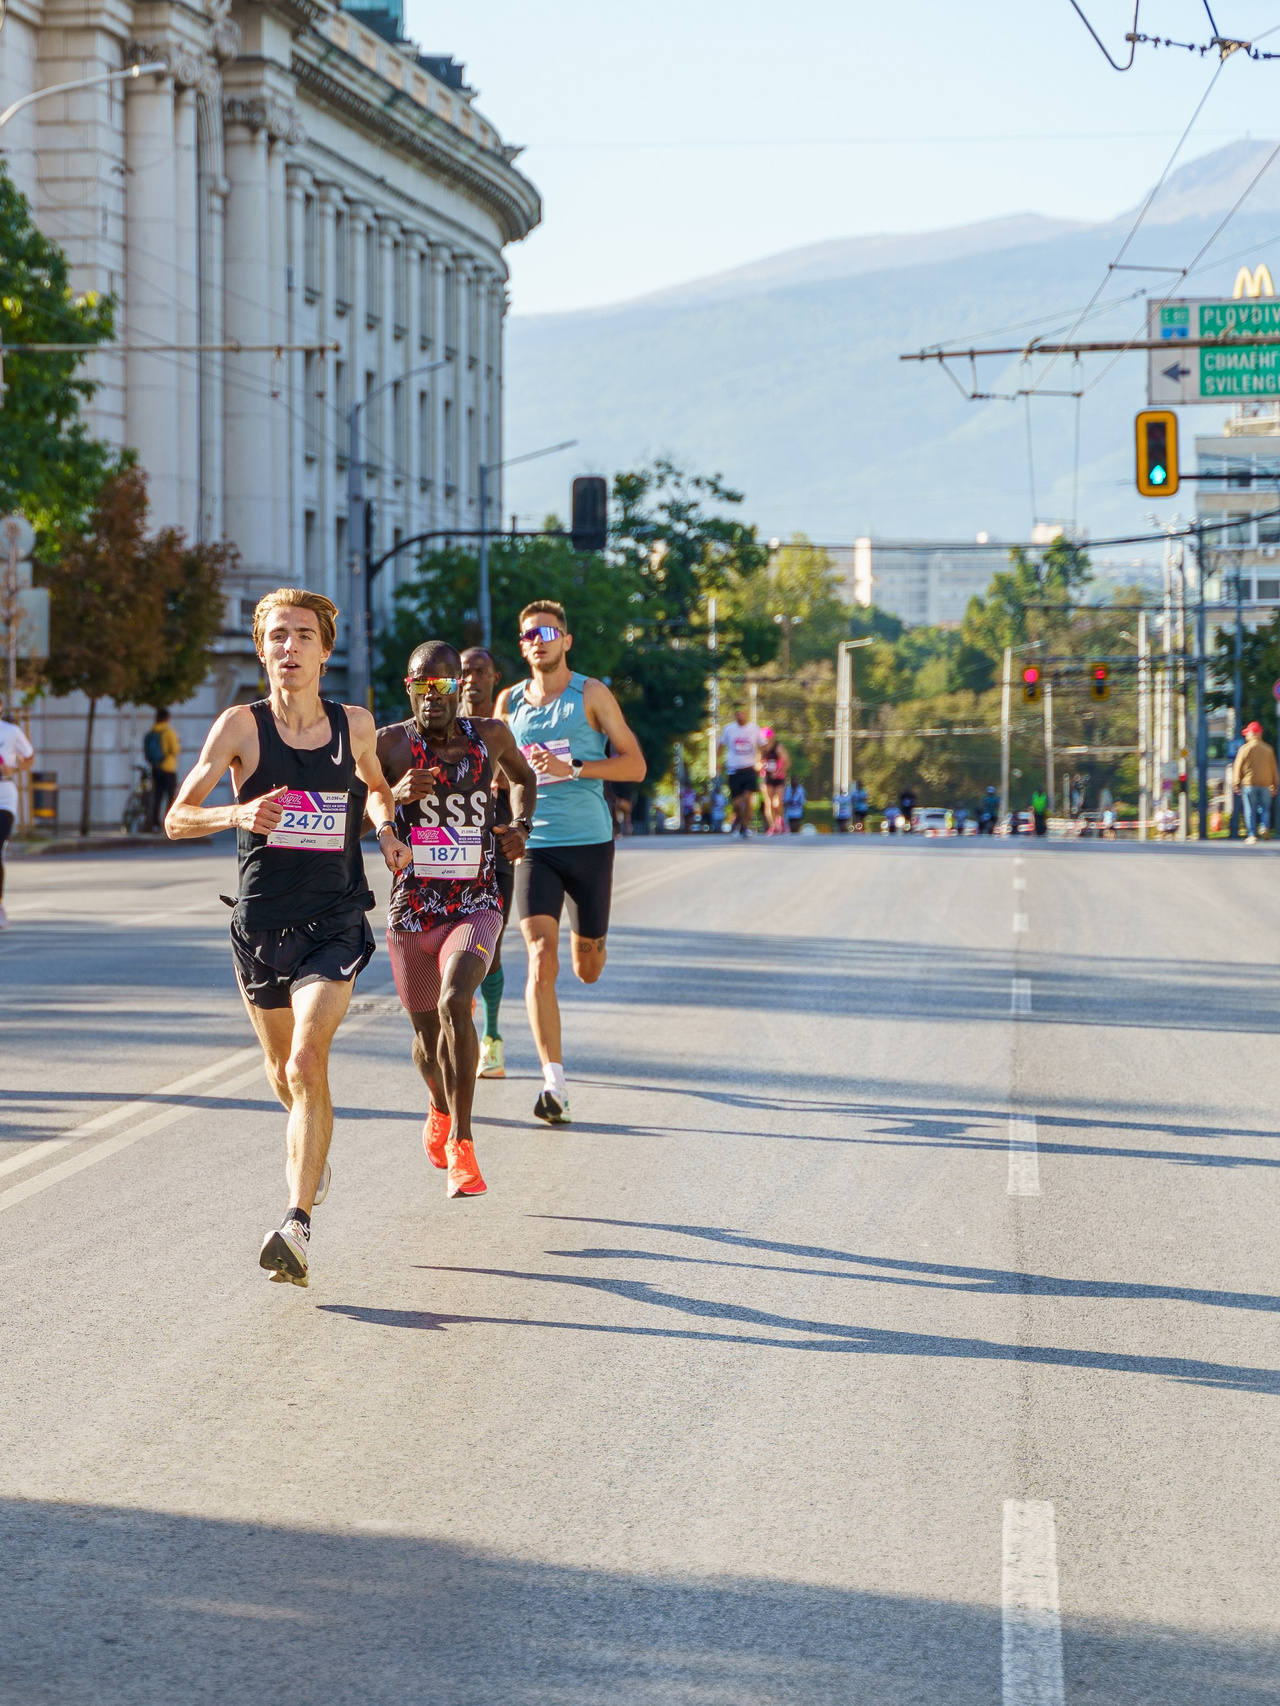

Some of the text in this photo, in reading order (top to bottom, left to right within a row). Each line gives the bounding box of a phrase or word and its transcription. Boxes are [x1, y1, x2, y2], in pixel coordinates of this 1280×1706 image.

[1205, 373, 1280, 395] SVILENG
[283, 812, 335, 830] 2470
[429, 847, 466, 861] 1871
